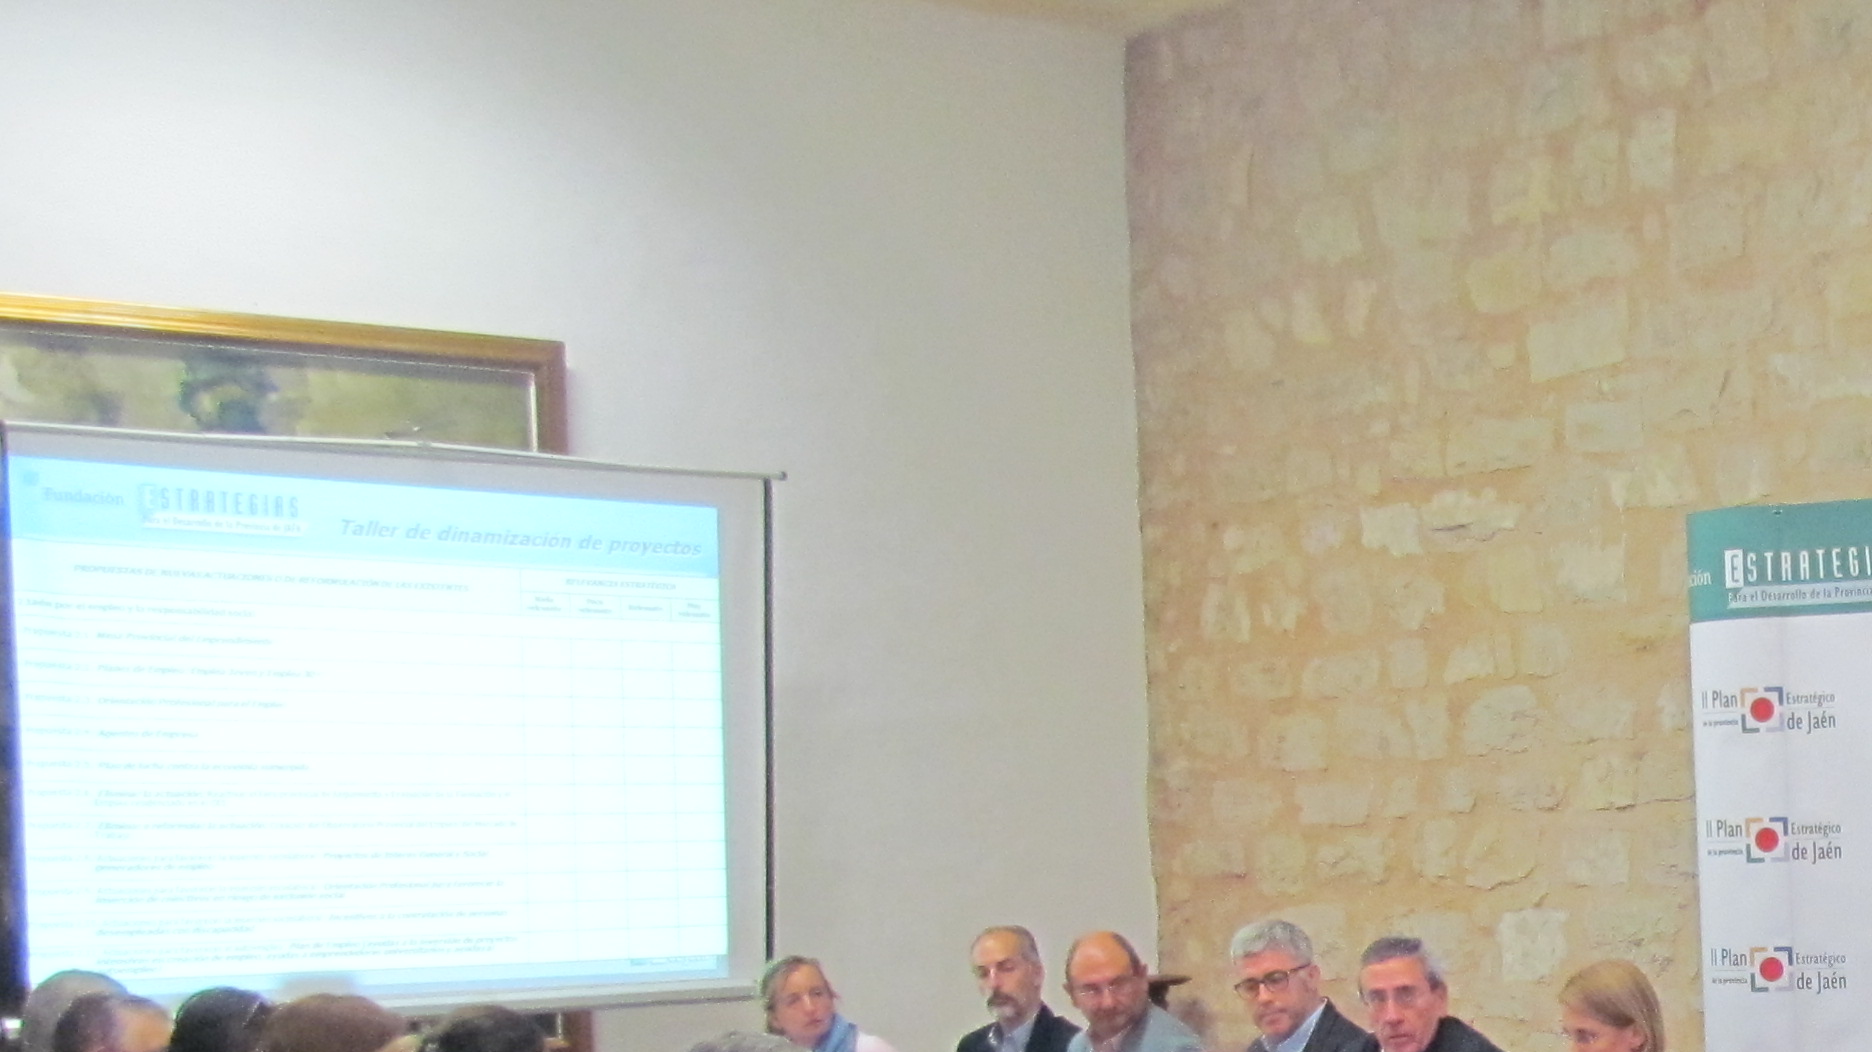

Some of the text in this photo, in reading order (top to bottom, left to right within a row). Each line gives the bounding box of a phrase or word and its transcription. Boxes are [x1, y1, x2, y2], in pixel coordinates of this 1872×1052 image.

[42, 486, 125, 507] Fundación
[340, 518, 703, 557] Taller de dinamización de proyectos
[1750, 592, 1758, 601] el
[1761, 590, 1807, 601] Desarrollo
[1810, 588, 1820, 599] de
[1823, 588, 1832, 598] la
[1712, 690, 1738, 708] Plan
[1787, 691, 1835, 707] Estratégico
[1787, 712, 1803, 730] de
[1807, 710, 1836, 735] Jaén
[1717, 819, 1742, 837] Plan
[1791, 822, 1841, 838] Estratégico
[1792, 842, 1808, 860] de
[1812, 841, 1842, 865] Jaén
[1722, 948, 1747, 967] Plan
[1795, 951, 1846, 968] Estratégico
[1797, 972, 1812, 990] de
[1817, 971, 1847, 994] Jaén
